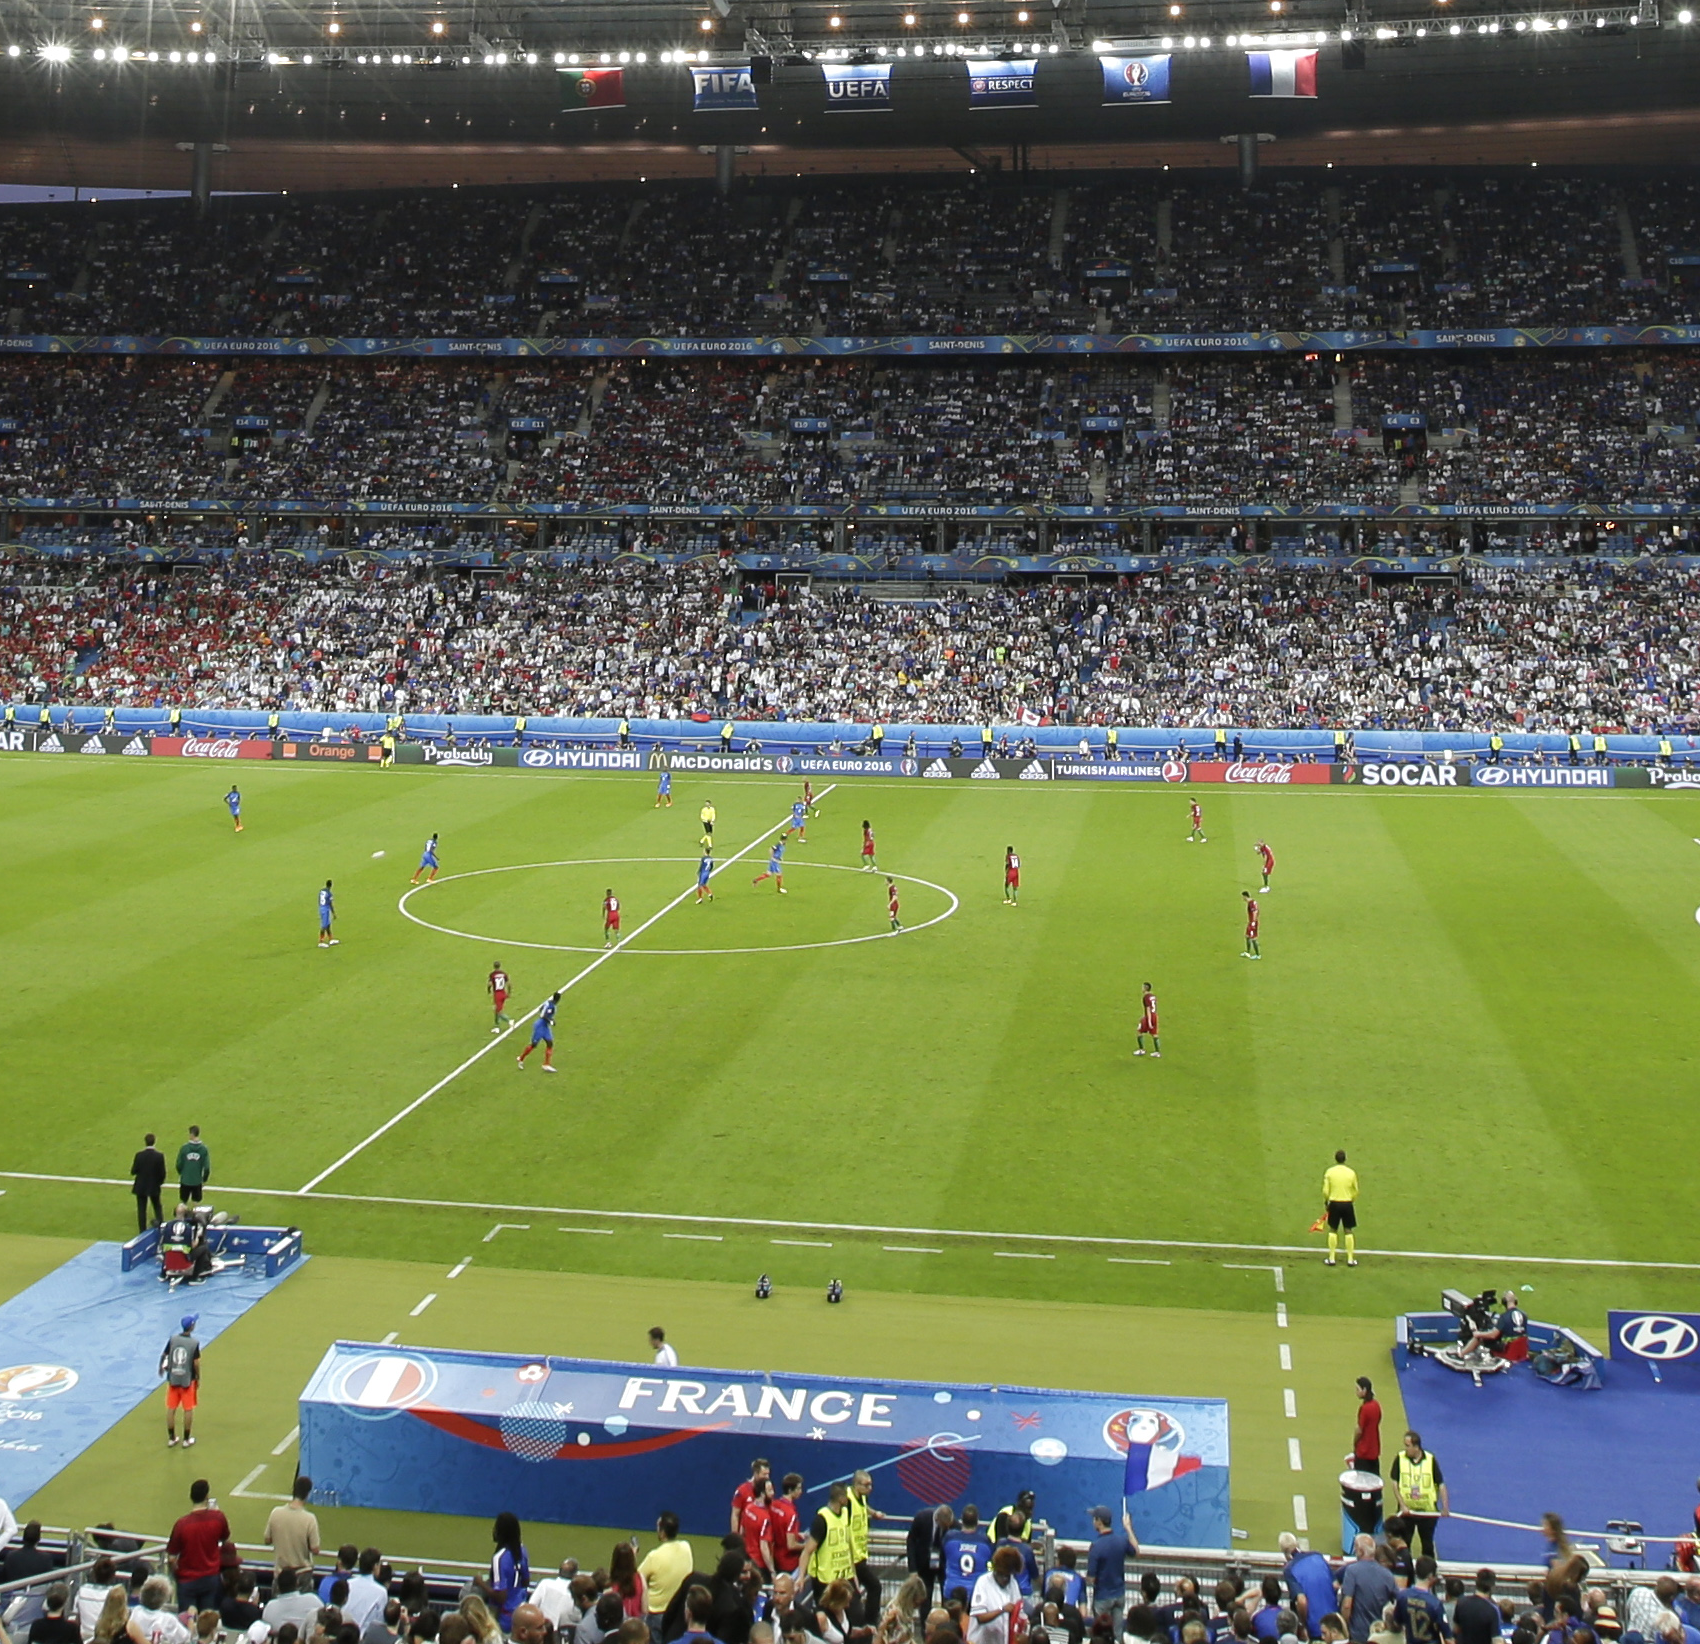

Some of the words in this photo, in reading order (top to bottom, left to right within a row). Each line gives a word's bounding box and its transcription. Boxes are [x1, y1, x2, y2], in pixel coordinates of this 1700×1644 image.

[693, 73, 755, 94] FIFA
[988, 79, 1033, 91] RESPECT
[829, 80, 887, 98] UEFA
[1166, 338, 1192, 347] UEFA
[1194, 337, 1221, 347] EURO
[1223, 337, 1248, 347] 2016
[1436, 333, 1495, 344] SAINT-DENIS
[204, 341, 227, 350] UEFA
[228, 341, 251, 350] EURO
[252, 341, 279, 350] 2016
[673, 342, 698, 351] UEFA
[702, 342, 726, 351] EURO
[728, 342, 752, 351] 2016
[928, 340, 985, 349] SAINT-DENIS
[139, 501, 188, 509] SAINT-DENIS
[380, 503, 403, 512] UEFA
[404, 503, 427, 512] EURO
[428, 503, 452, 512] 2016
[648, 506, 700, 514] SAINT-DENIS
[1455, 506, 1481, 514] UEFA
[1483, 506, 1509, 514] EURO
[1511, 505, 1536, 514] 2016
[901, 507, 926, 515] UEFA
[928, 507, 951, 515] EURO
[953, 506, 977, 515] 2016
[1185, 506, 1240, 515] SAINT-DENIS
[39, 743, 65, 753] adidas
[80, 745, 106, 754] adidas
[122, 747, 148, 756] adidas
[182, 737, 242, 757] Coca-Cola
[309, 744, 356, 760] Orange
[422, 745, 493, 765] Probably
[555, 751, 641, 768] HYUNDAI
[670, 756, 773, 771] McDonald's
[801, 760, 828, 771] UEFA
[830, 760, 862, 771] EURO
[864, 760, 892, 772] 2016
[922, 769, 952, 779] adidas
[971, 770, 1000, 780] adidas
[1019, 771, 1049, 780] adidas
[1056, 764, 1106, 776] TURKISH
[1108, 766, 1161, 777] AIRLINES
[1225, 762, 1294, 784] Coca-Cola
[1362, 764, 1457, 786] SOCAR
[1512, 769, 1608, 785] HYUNDAI
[618, 1375, 898, 1428] FRANCE
[959, 1555, 975, 1574] 9
